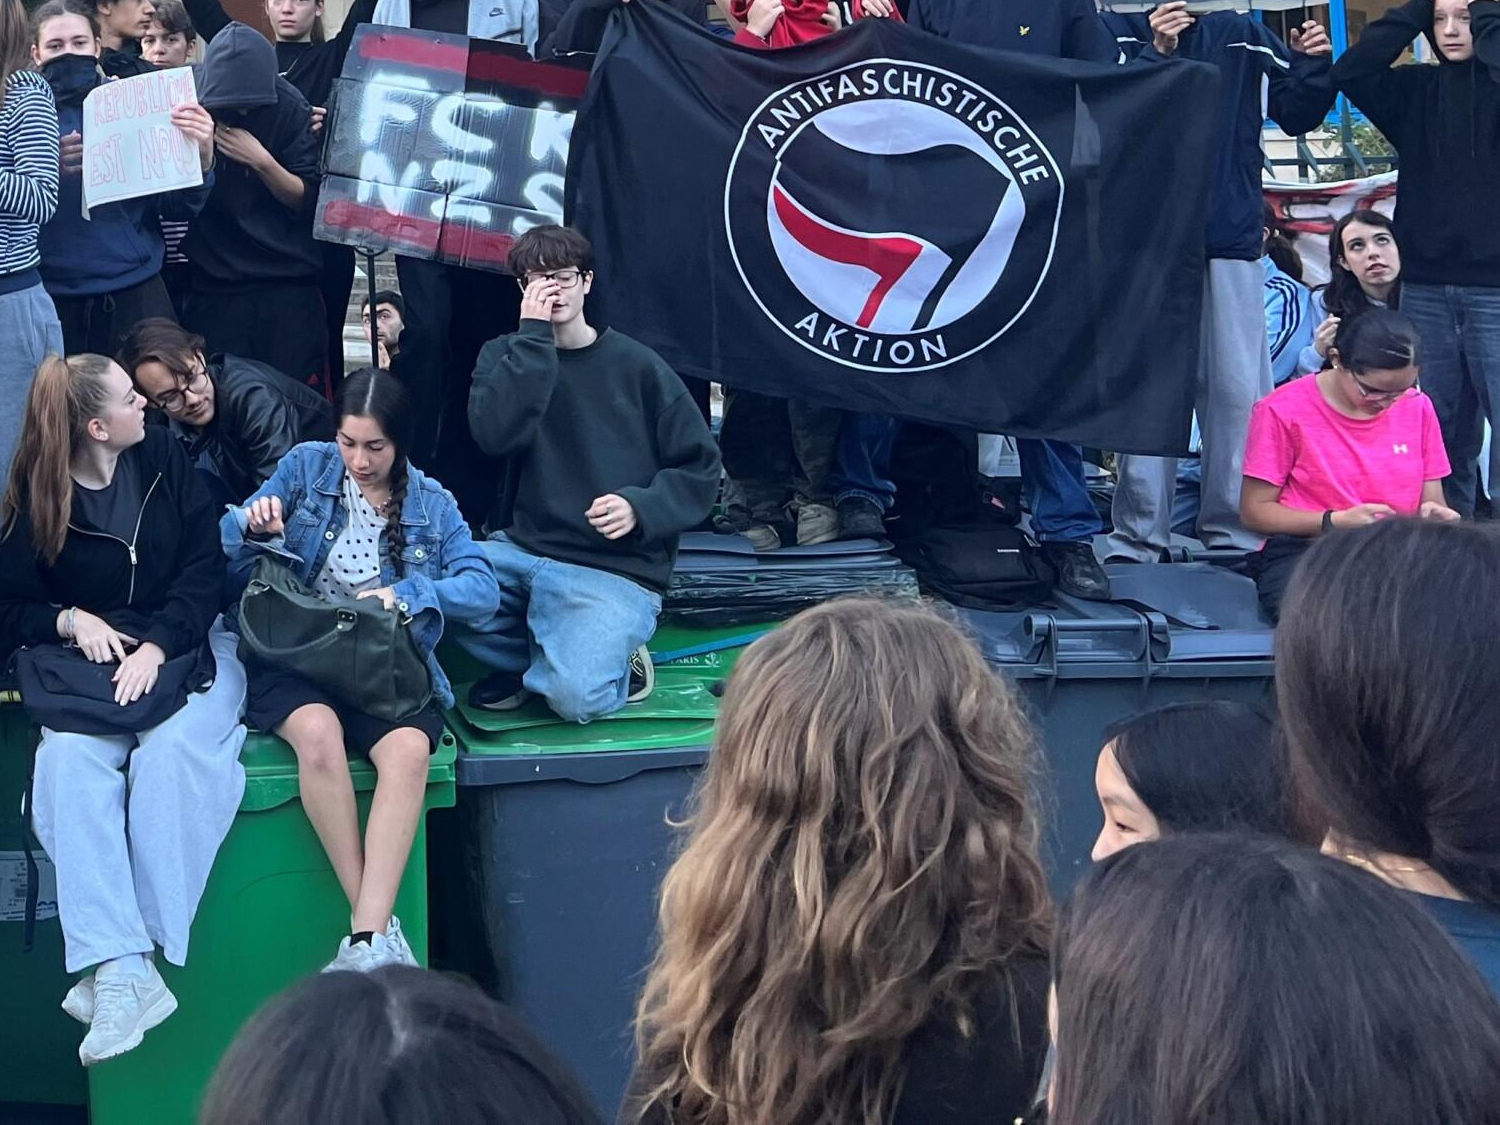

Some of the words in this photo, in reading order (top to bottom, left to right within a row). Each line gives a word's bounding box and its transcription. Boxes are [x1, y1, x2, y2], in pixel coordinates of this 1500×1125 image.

[360, 72, 577, 165] FCK
[756, 68, 1050, 186] ANTIFASCHISTISCHE
[89, 132, 126, 187] EST
[795, 312, 948, 365] AKTION
